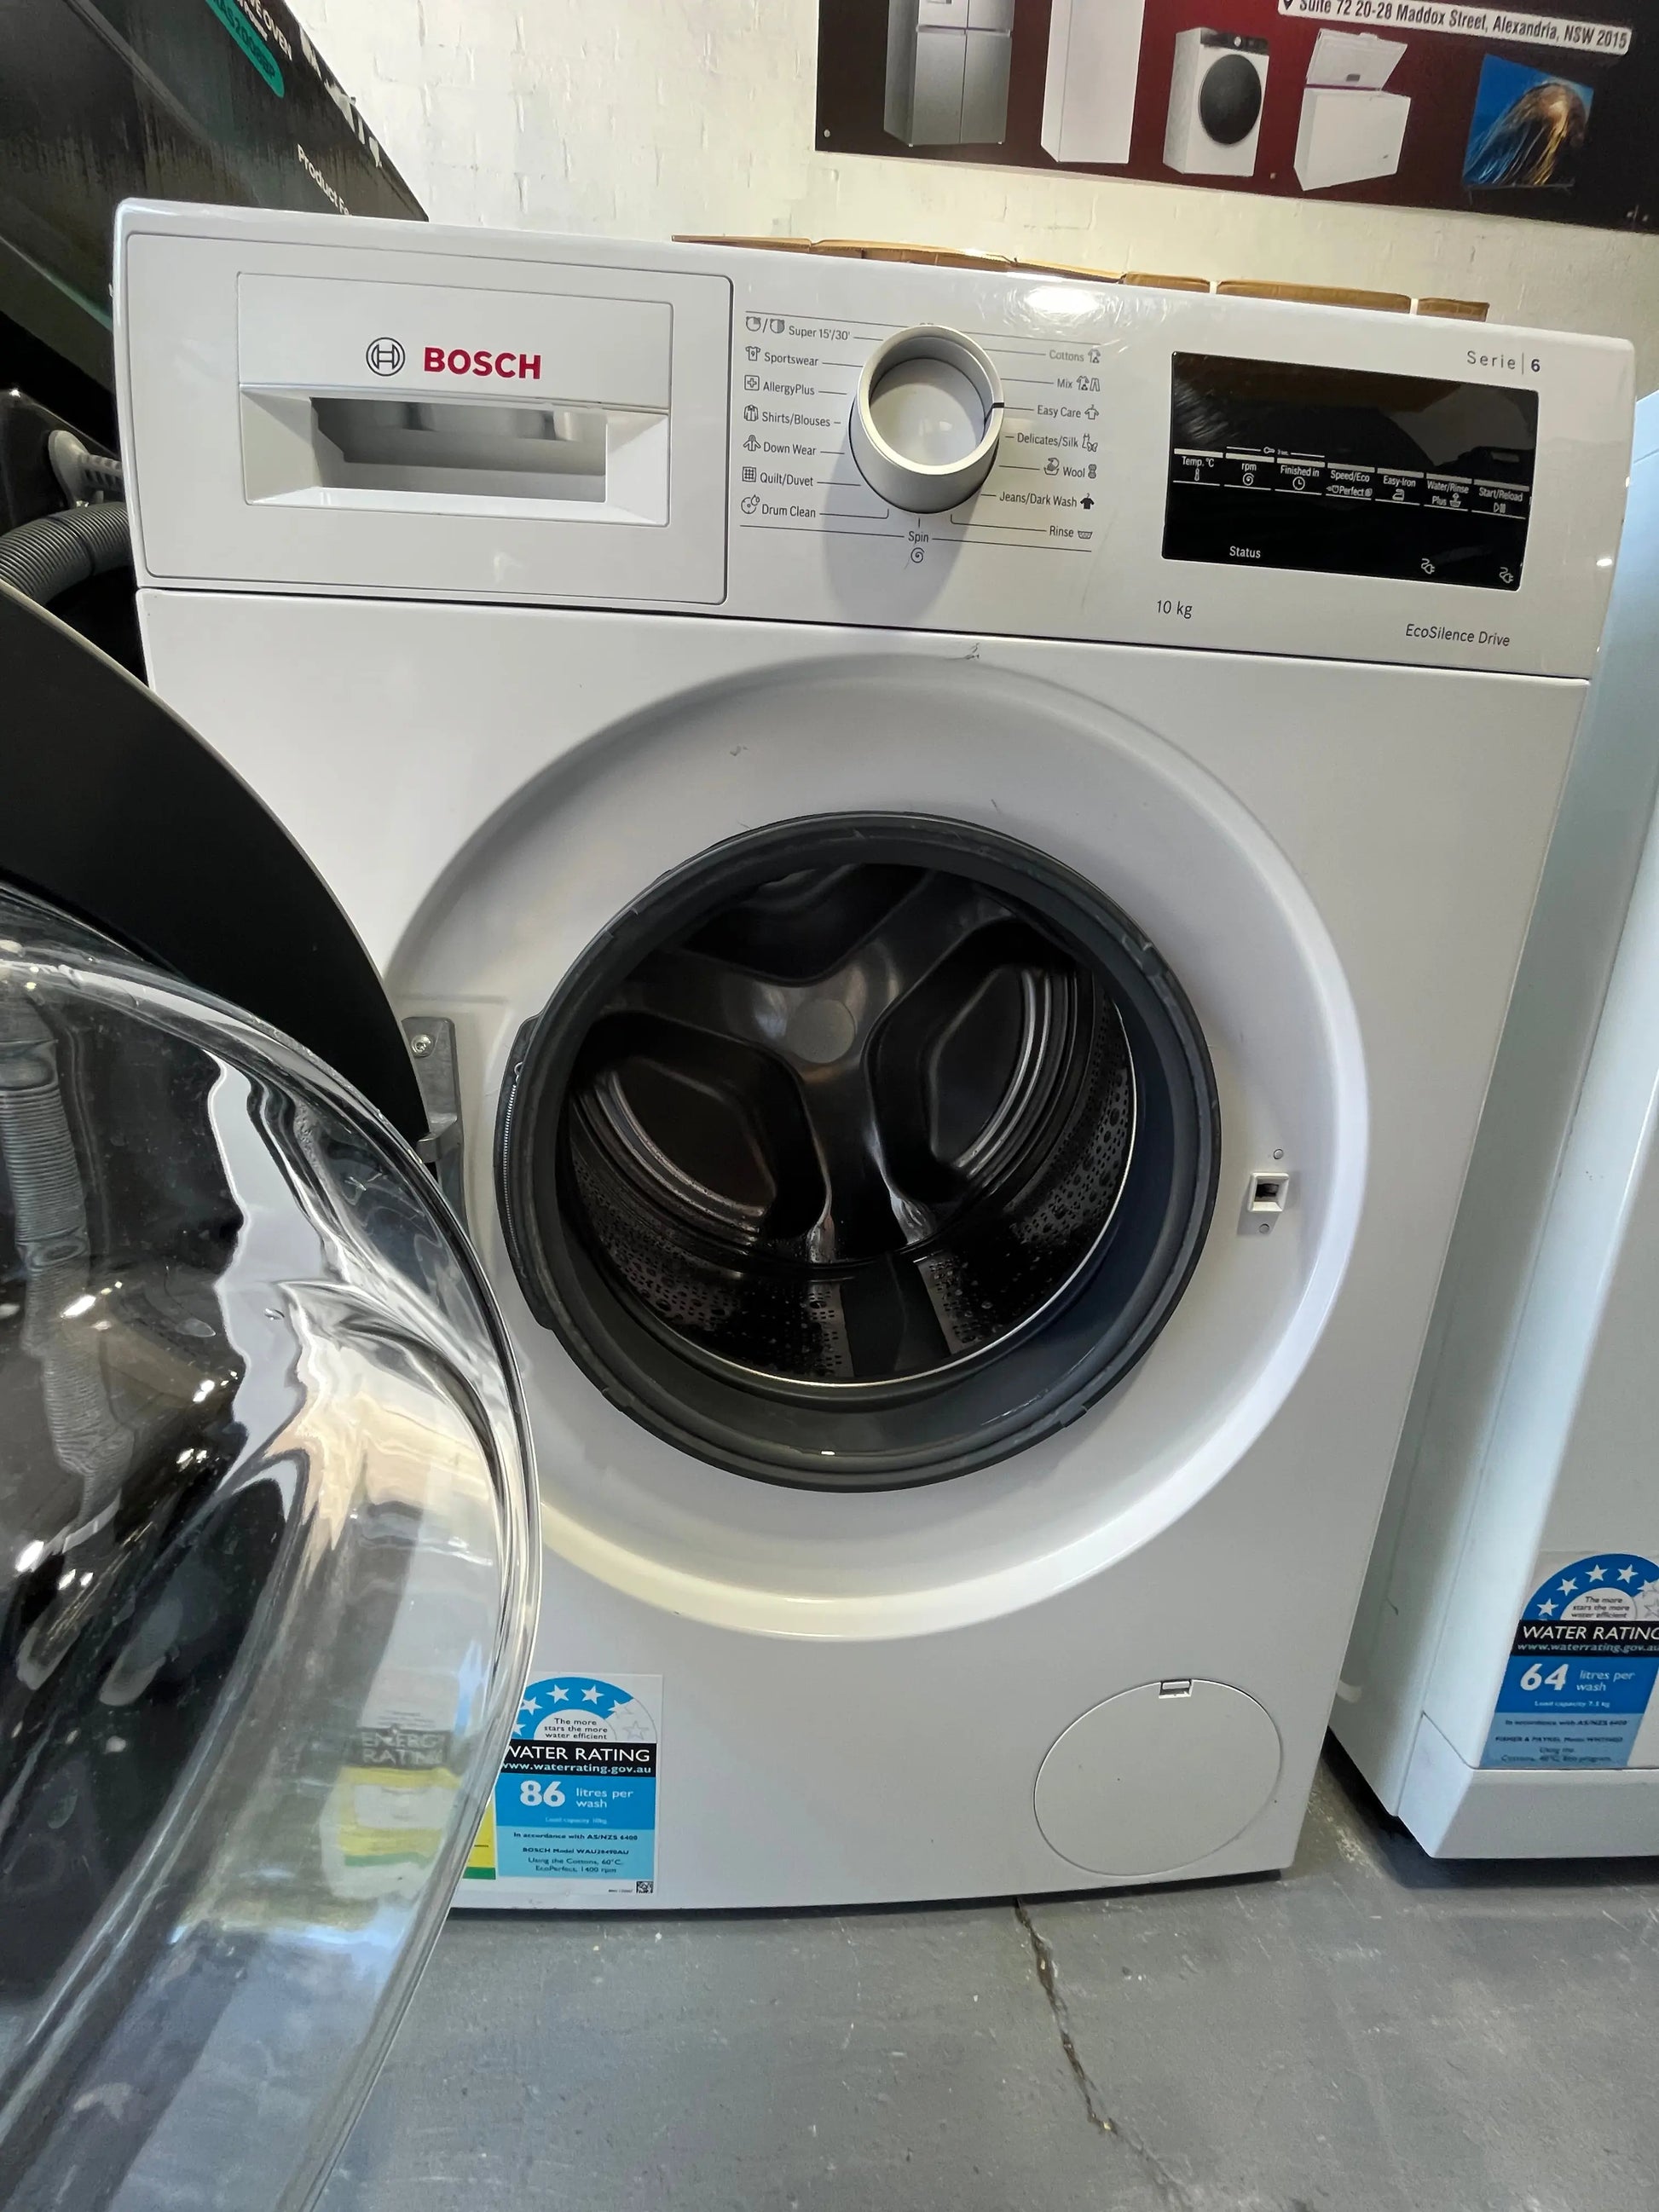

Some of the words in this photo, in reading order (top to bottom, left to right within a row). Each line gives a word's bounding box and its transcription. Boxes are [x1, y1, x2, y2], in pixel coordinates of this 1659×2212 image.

[1337, 0, 1351, 15] 72
[1355, 1, 1392, 20] 20-28
[1396, 7, 1446, 26] Maddox
[1449, 9, 1488, 32] Street,
[1493, 15, 1560, 42] Alexandria,
[1564, 25, 1594, 43] NSW
[1596, 29, 1627, 49] 2015
[298, 143, 338, 208] Product
[789, 325, 817, 338] Super
[819, 328, 851, 340] 15'/30'
[764, 352, 818, 366] Sportswear
[1049, 349, 1084, 362] Cottons
[1466, 350, 1516, 370] Serie
[1530, 359, 1540, 373] 6
[424, 346, 541, 380] BOSCH
[763, 381, 815, 396] AllergyPlus
[1057, 378, 1072, 389] Mix
[762, 411, 830, 427] Shirts/Blouses
[1037, 405, 1058, 419] Easy
[1061, 407, 1081, 419] Care
[1017, 432, 1078, 448] Delicates/Silk
[763, 442, 790, 453] Down
[792, 444, 817, 456] Wear
[1182, 456, 1205, 467] Temp.
[1241, 463, 1257, 471] rpm
[1062, 466, 1085, 478] Wool
[1280, 465, 1310, 476] Finished
[1312, 469, 1320, 477] in
[1330, 470, 1370, 482] Speed/Eco
[760, 472, 813, 487] Quilt/Duvet
[1383, 476, 1416, 488] Easy-Iron
[1427, 480, 1470, 494] Water/Rinse
[999, 491, 1050, 505] Jeans/Dark
[1053, 495, 1077, 507] Wash
[1431, 496, 1447, 506] Plus
[1479, 488, 1523, 502] Start/Reload
[761, 504, 788, 516] Drum
[789, 505, 816, 518] Clean
[908, 530, 929, 543] Spin
[1049, 525, 1074, 538] Rinse
[1229, 546, 1261, 558] Status
[1157, 600, 1172, 614] 10
[1176, 601, 1193, 619] kg
[1406, 623, 1475, 642] EcoSilence
[1478, 631, 1510, 647] Drive
[1523, 1626, 1587, 1639] WATER
[1520, 1663, 1569, 1691] 64
[1580, 1670, 1610, 1680] litres
[1613, 1672, 1635, 1683] per
[1576, 1682, 1607, 1691] wash
[575, 1747, 650, 1762] RATING
[520, 1780, 565, 1807] 86
[575, 1788, 607, 1798] litres
[612, 1789, 633, 1800] per
[575, 1799, 607, 1808] wash
